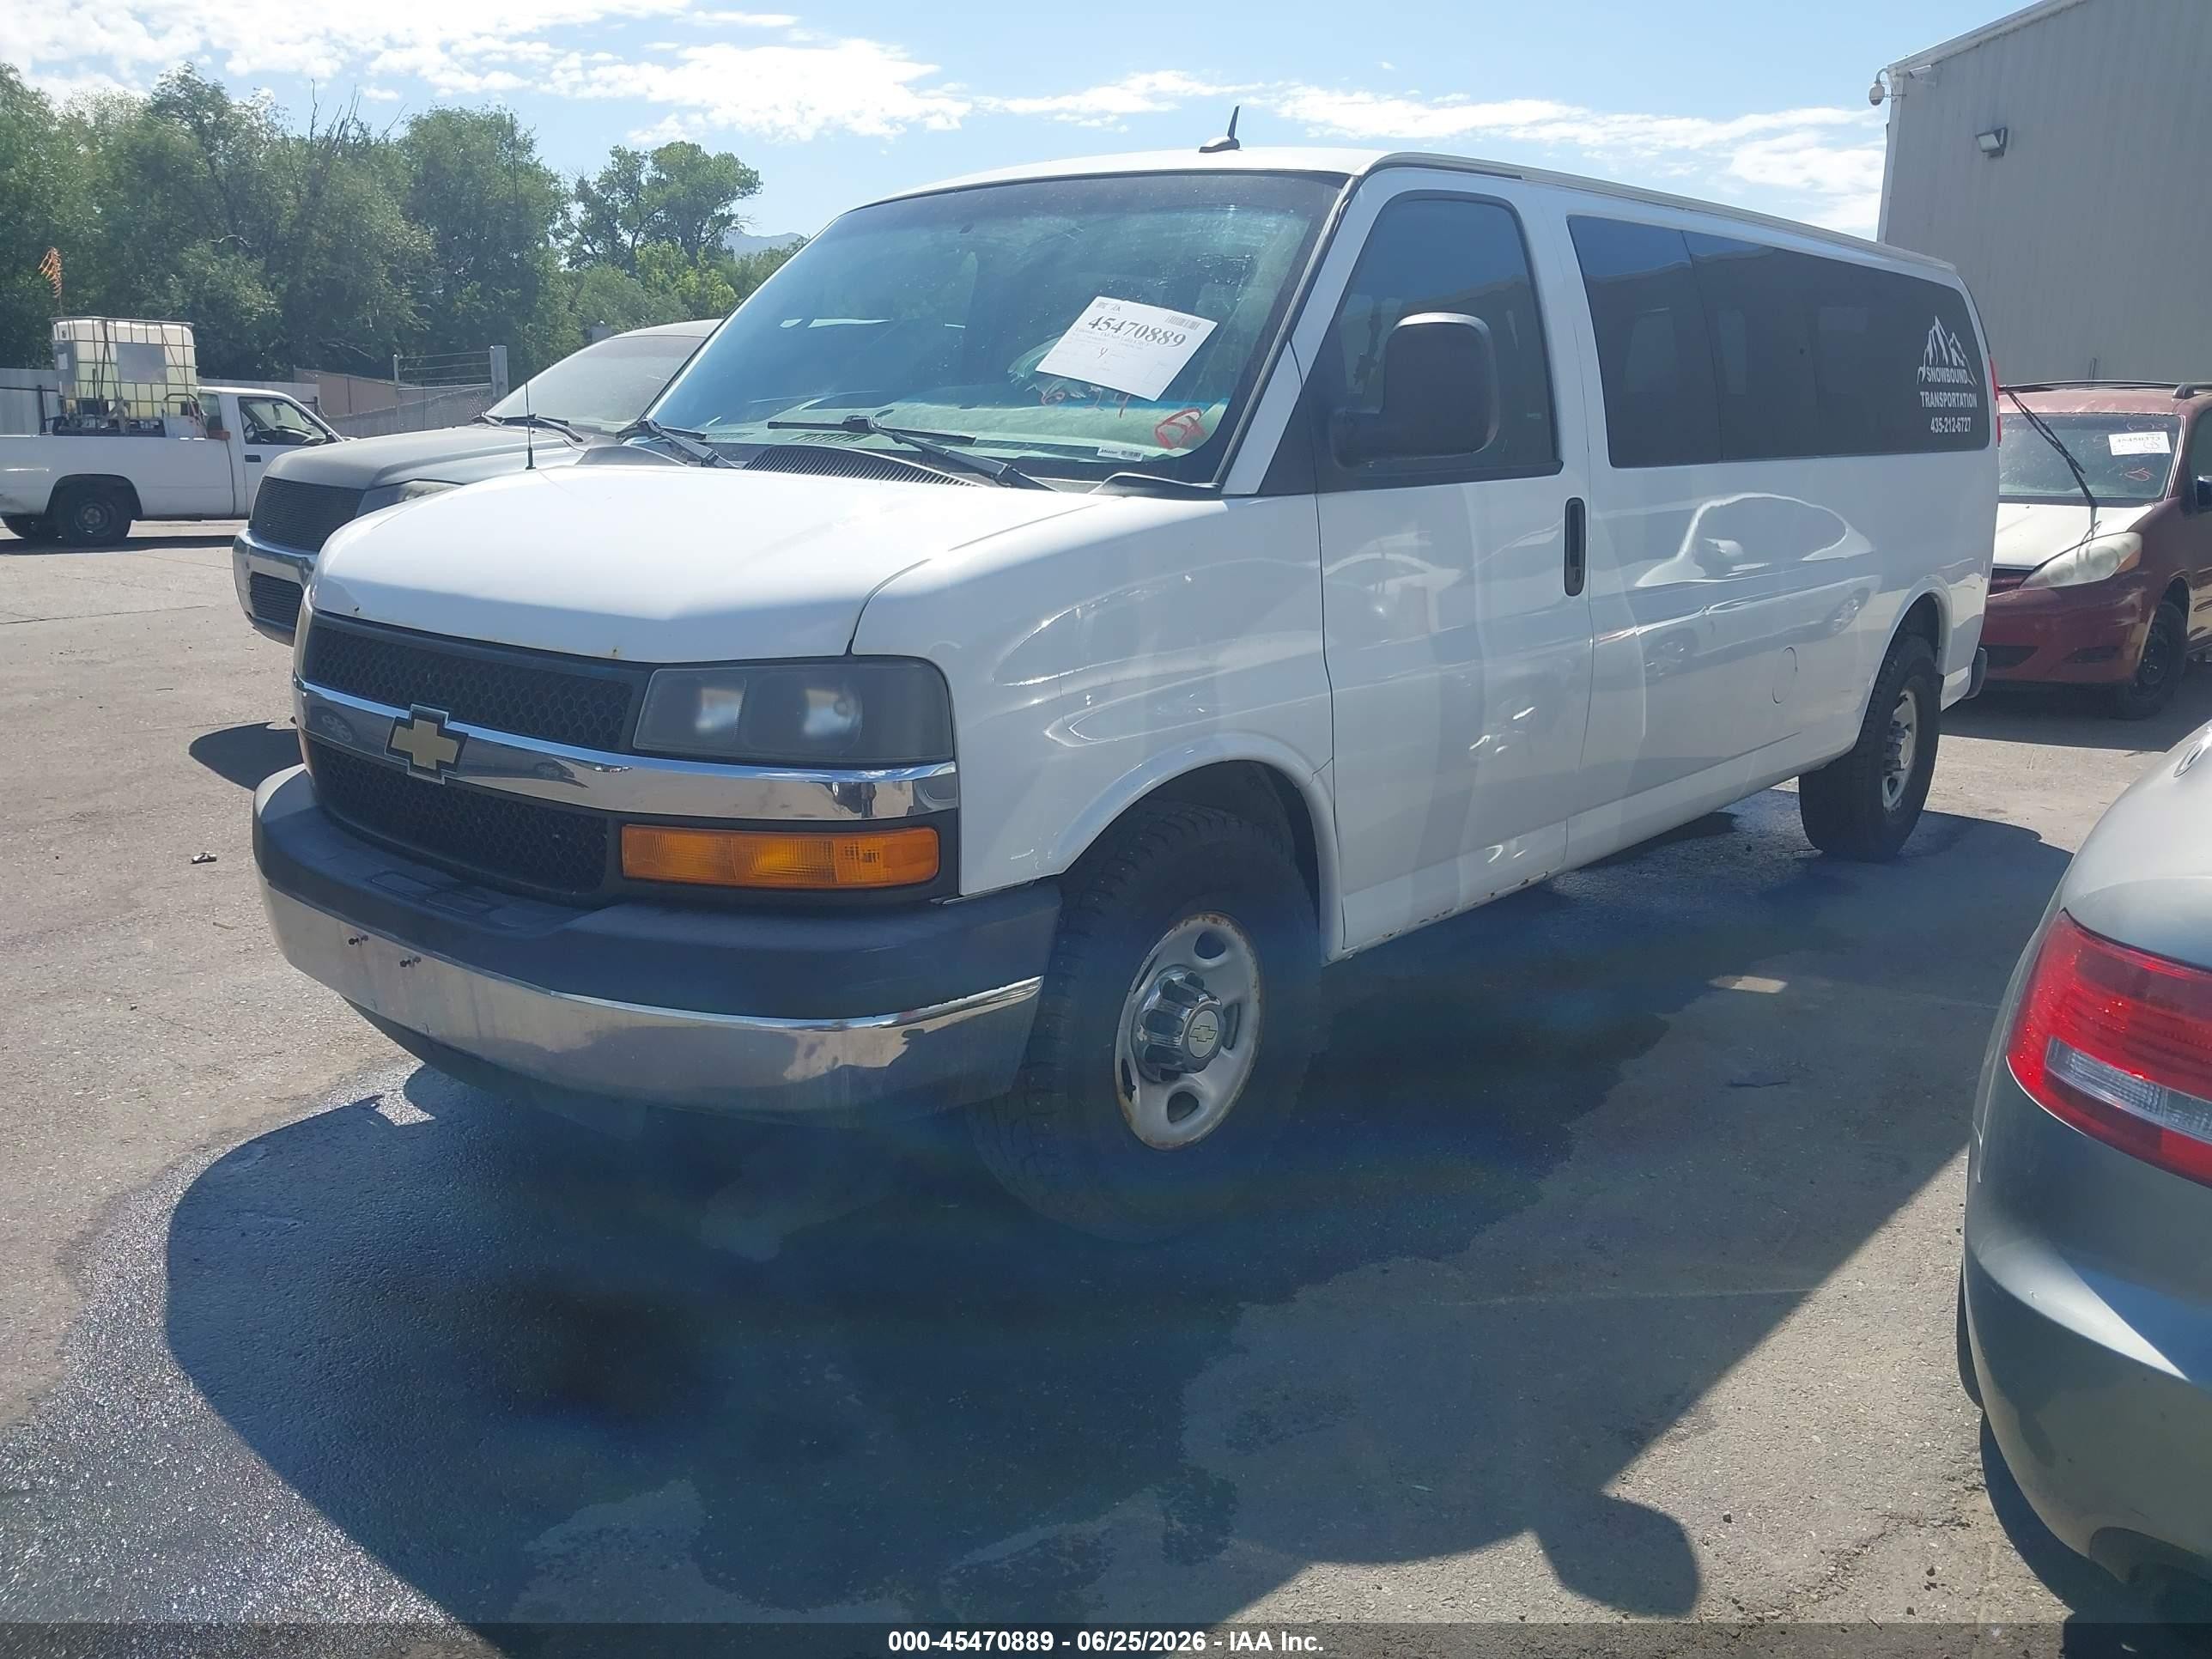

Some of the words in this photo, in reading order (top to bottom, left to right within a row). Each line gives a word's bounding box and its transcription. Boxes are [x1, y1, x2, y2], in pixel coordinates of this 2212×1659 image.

[1088, 315, 1186, 348] 45470889
[1926, 367, 1967, 384] SNOWBOUND
[1920, 392, 1977, 408] TRANSPORTATION
[1930, 417, 1971, 433] 435-212-6727
